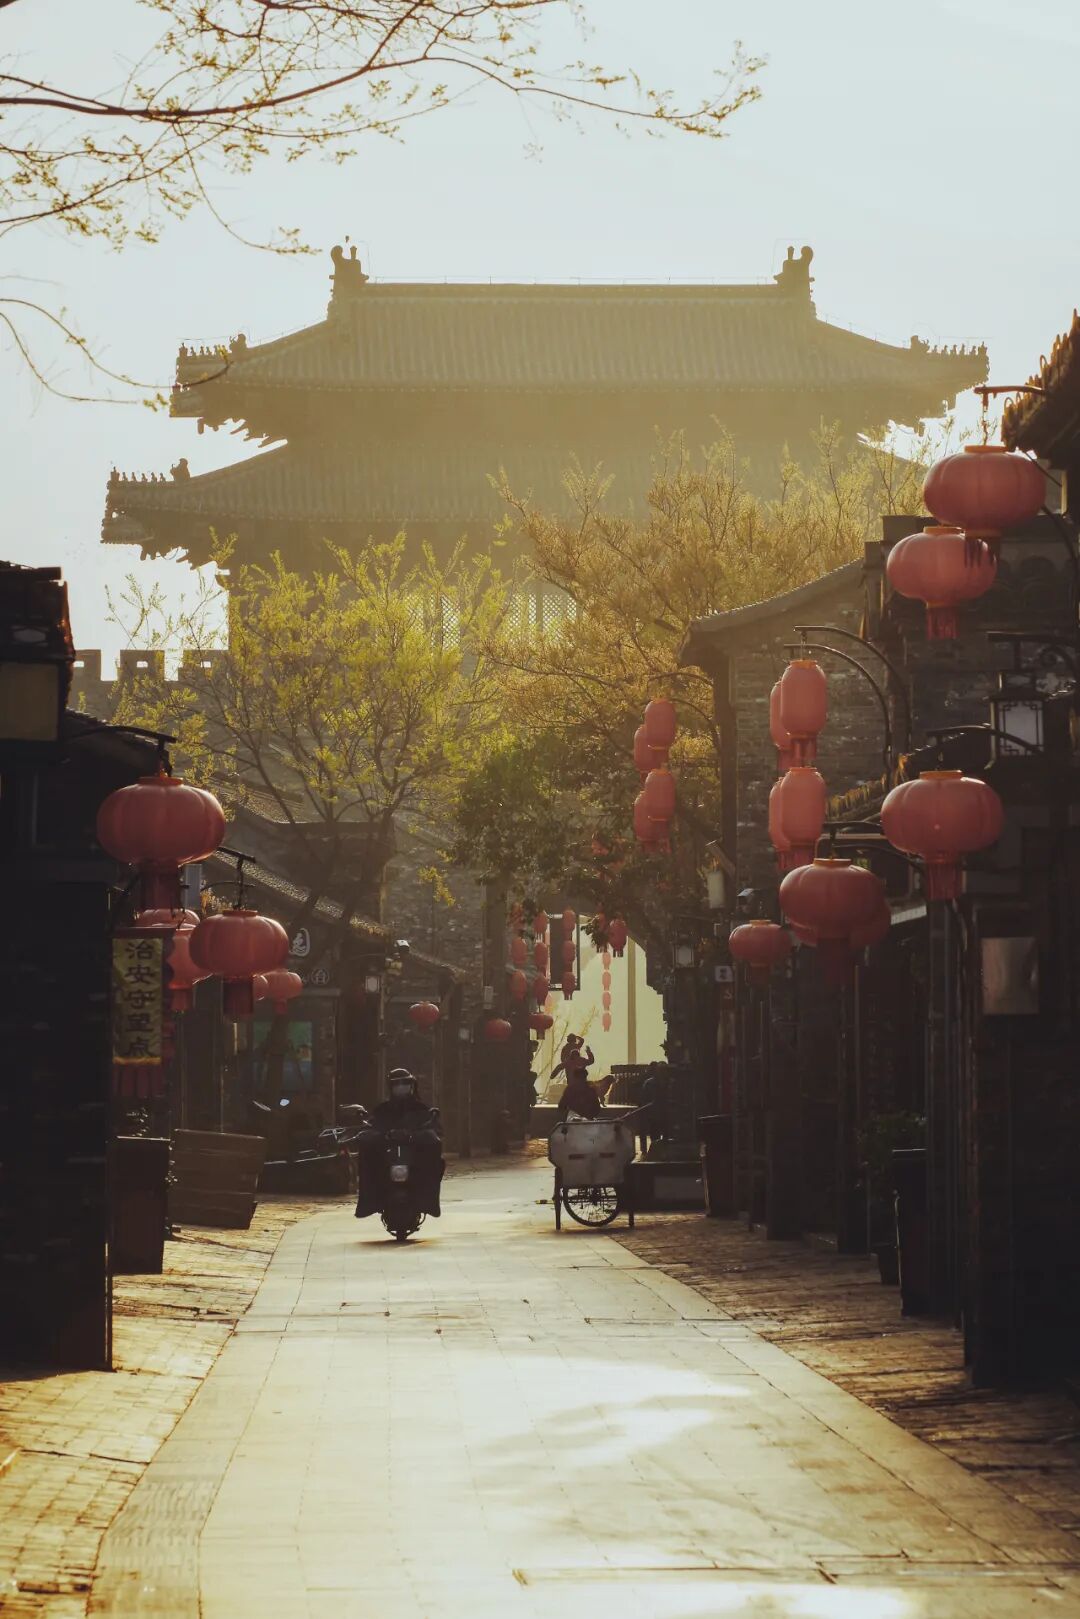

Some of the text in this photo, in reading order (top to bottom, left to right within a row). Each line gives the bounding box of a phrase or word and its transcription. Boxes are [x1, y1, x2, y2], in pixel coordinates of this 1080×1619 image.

[124, 940, 155, 1057] 治安守望点
